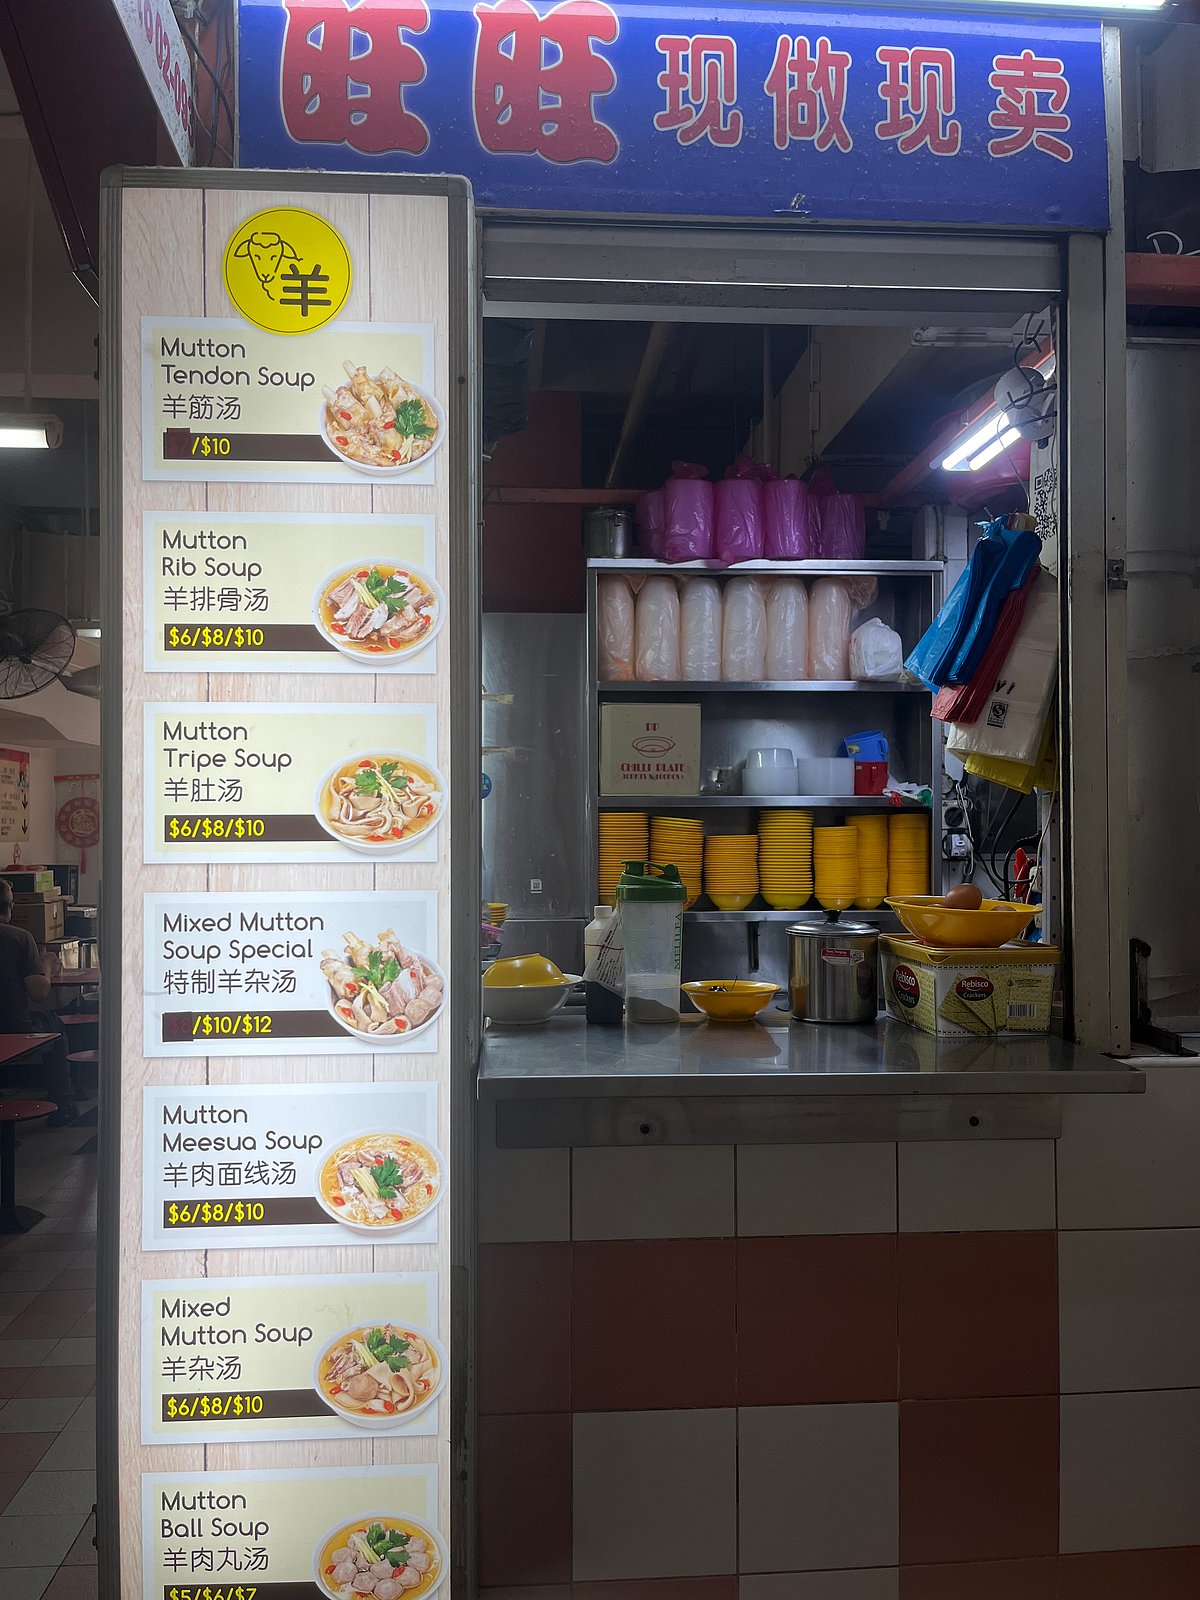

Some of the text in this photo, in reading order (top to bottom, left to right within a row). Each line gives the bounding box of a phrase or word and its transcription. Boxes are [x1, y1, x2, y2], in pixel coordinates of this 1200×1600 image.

[279, 0, 1074, 165] 旺旺 现做现卖
[280, 263, 332, 317] 羊
[161, 336, 246, 359] Mutton
[161, 364, 316, 390] Tendon Soup
[161, 393, 241, 421] 羊筋汤
[162, 529, 247, 550] Mutton
[162, 556, 262, 580] Rib Soup
[163, 585, 269, 612] 羊排骨汤
[169, 626, 264, 649] $6/$8/$10
[163, 721, 248, 741] Mutton
[163, 748, 292, 771] Tripe Soup
[621, 763, 685, 772] CHILLI PLATE
[163, 777, 243, 803] 羊肚汤
[169, 817, 265, 839] $6/$8/$10
[163, 911, 324, 933] Mixed Mutton
[163, 938, 313, 964] Soup Special
[163, 968, 297, 995] 特制羊杂汤
[895, 969, 916, 987] Rebisco
[961, 980, 989, 989] Rebisco
[163, 1104, 248, 1125] Mutton
[163, 1130, 323, 1155] Meesua Soup
[163, 1160, 296, 1188] 羊肉面线汤
[168, 1201, 265, 1224] $6/$8/$10
[161, 1296, 231, 1319] Mixed
[161, 1323, 313, 1347] Mutton Soup
[161, 1355, 242, 1383] 羊杂汤
[167, 1394, 263, 1419] $6/$8/$10
[161, 1490, 247, 1512] Mutton
[161, 1517, 270, 1542] Ball Soup
[163, 1546, 269, 1574] 羊肉丸汤
